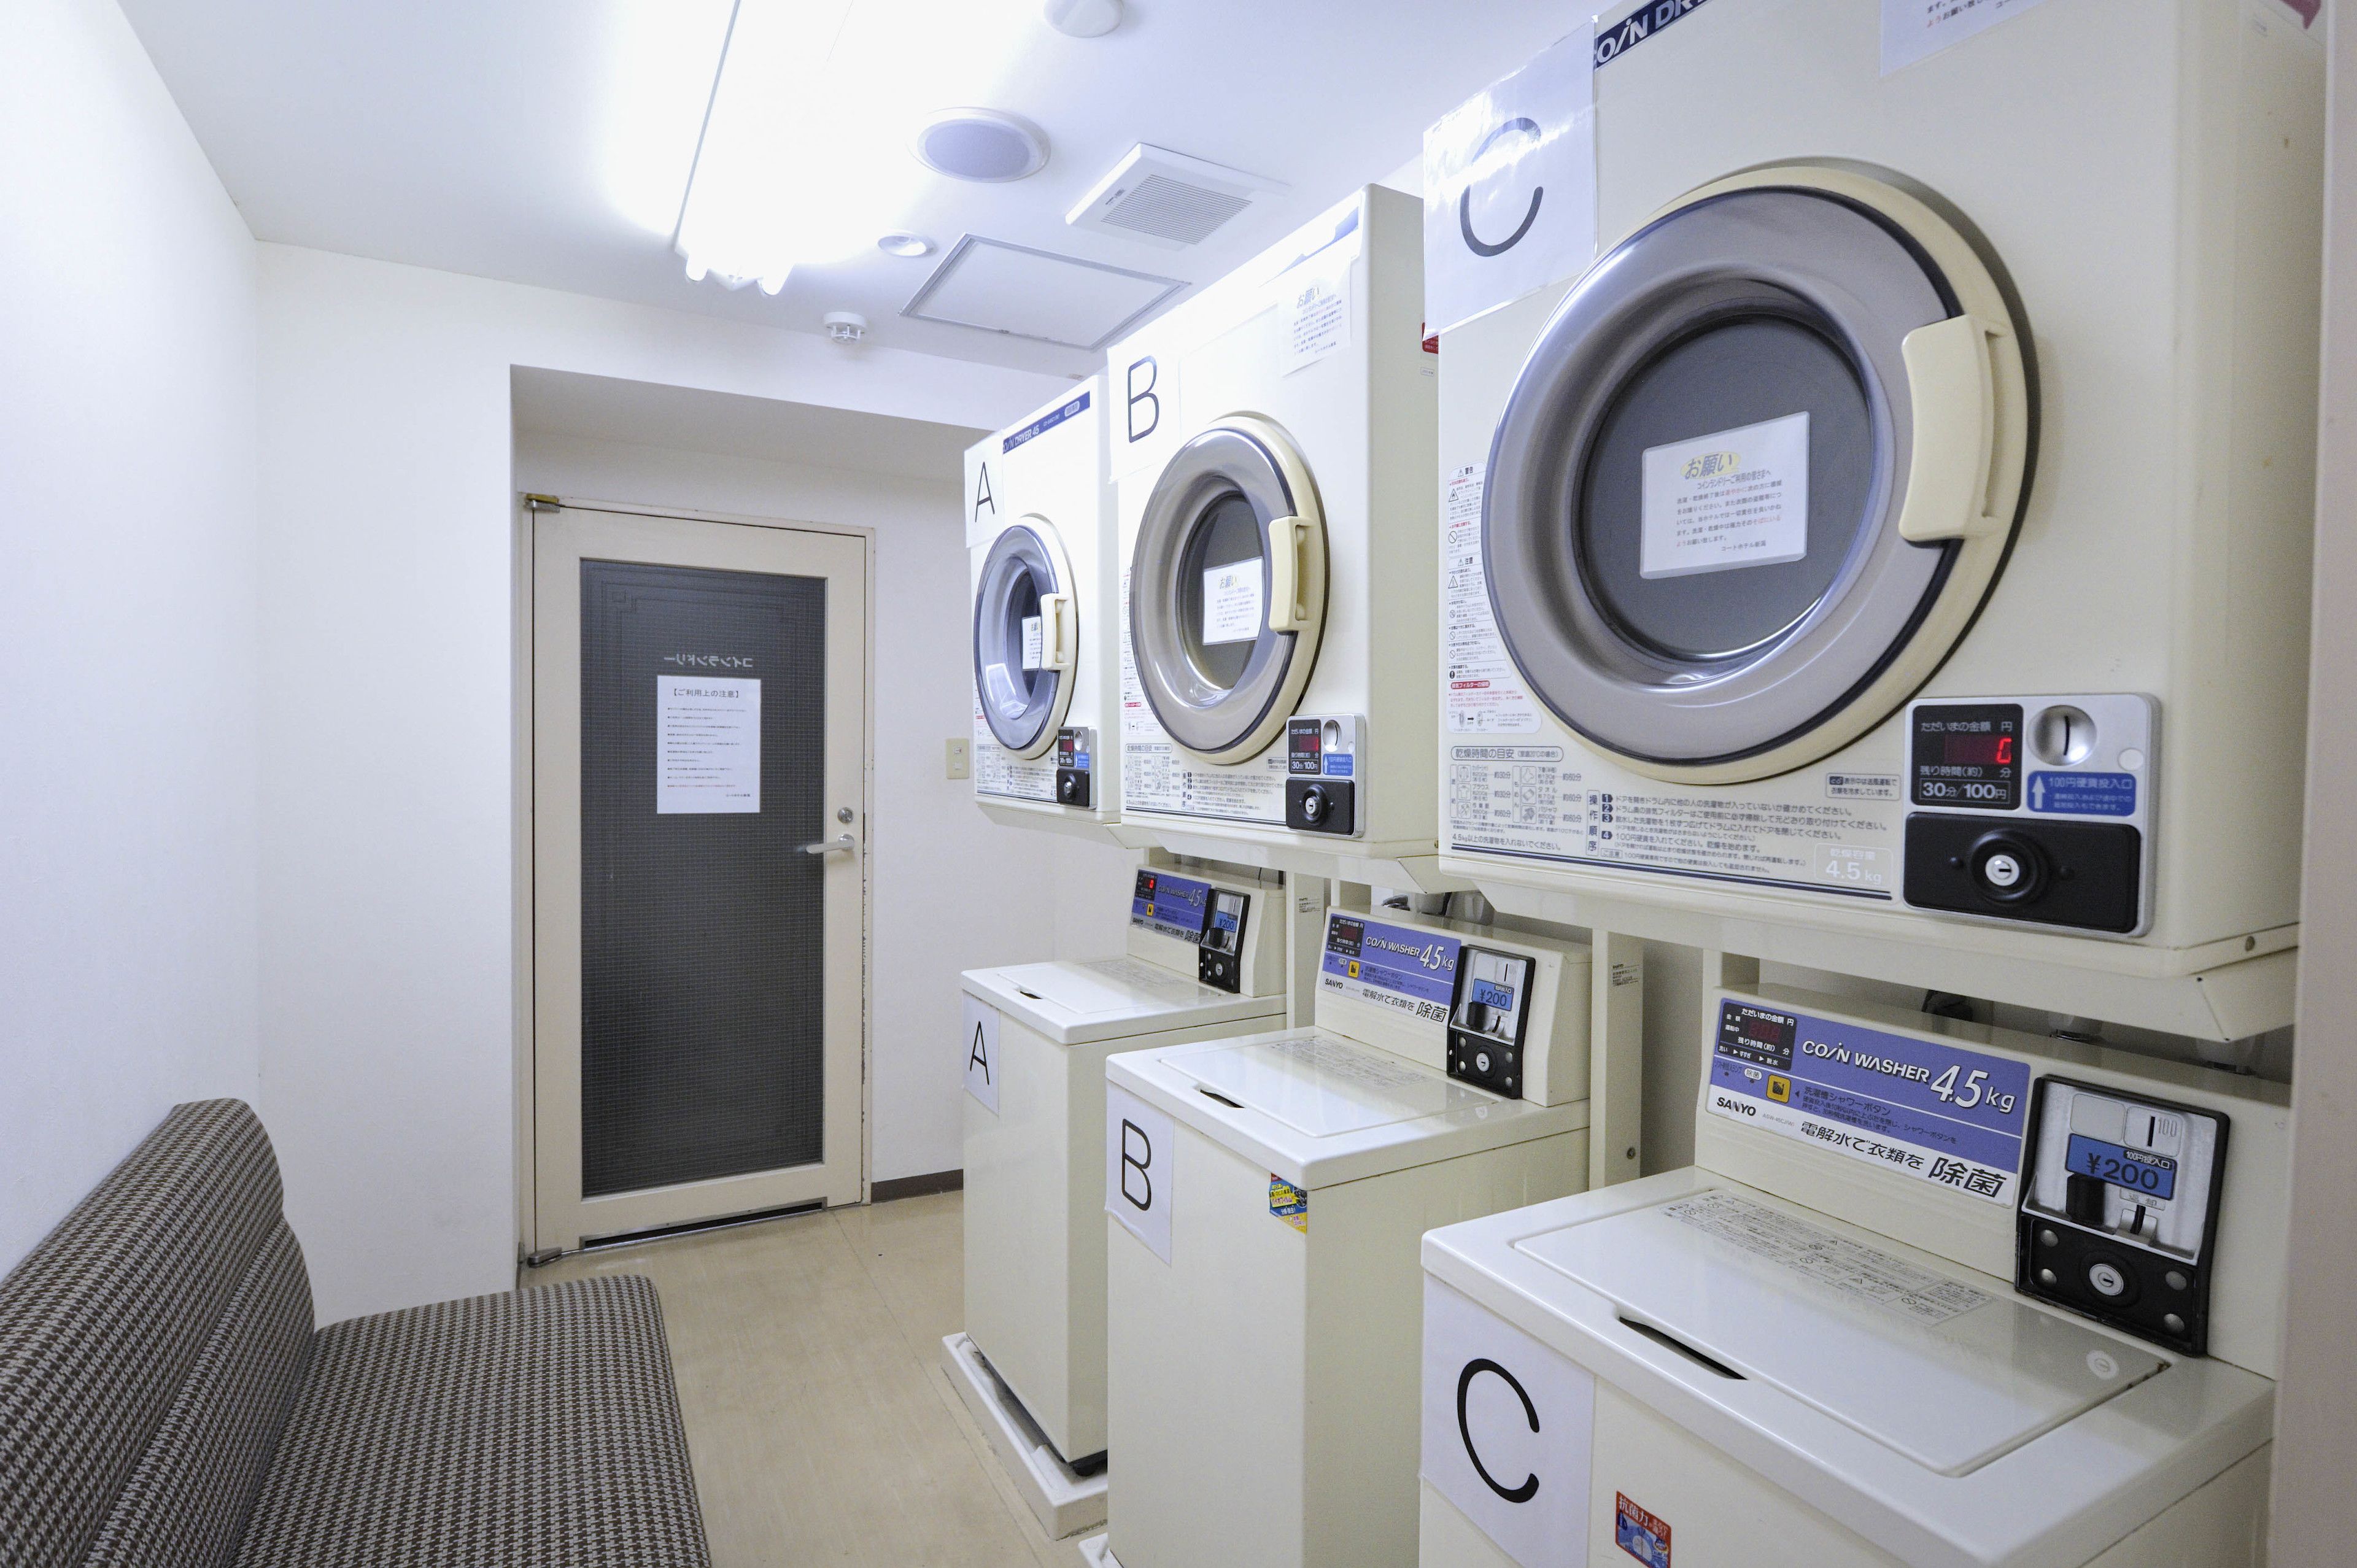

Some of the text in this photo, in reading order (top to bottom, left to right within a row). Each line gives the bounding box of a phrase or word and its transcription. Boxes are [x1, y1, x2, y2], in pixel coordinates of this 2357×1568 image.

[1595, 15, 1648, 63] OIN
[1460, 117, 1543, 257] C
[1128, 355, 1159, 443] B
[1684, 453, 1733, 479] お願い
[975, 462, 995, 522] A
[673, 688, 740, 698] 【ご利用上の注意】
[1920, 720, 2013, 732] ただいまの金額 円
[1455, 748, 1514, 760] 乾燥時間の目安
[1919, 767, 2012, 778] 残り時間(約) 分
[2049, 778, 2133, 790] 100円硬貨投入口
[1825, 860, 1882, 884] 4.5 kg
[1388, 941, 1420, 957] WASHER
[1324, 978, 1344, 989] SANYO
[1362, 987, 1449, 1023] 電解水で衣類を 除菌
[1479, 991, 1507, 1007] ¥200
[1741, 1007, 1794, 1027] ただいまの金額 円
[969, 1021, 990, 1086] A
[1782, 1047, 1790, 1056] 分
[1854, 1052, 1931, 1084] WASHER
[1716, 1096, 1757, 1117] SANYO
[1122, 1118, 1151, 1211] B
[1800, 1121, 2007, 1199] 電解水で衣類を 除菌
[2088, 1152, 2159, 1190] ¥200
[2126, 1151, 2170, 1168] 100円投入口
[1457, 1358, 1539, 1504] C
[1618, 1493, 1649, 1527] 抗菌力
